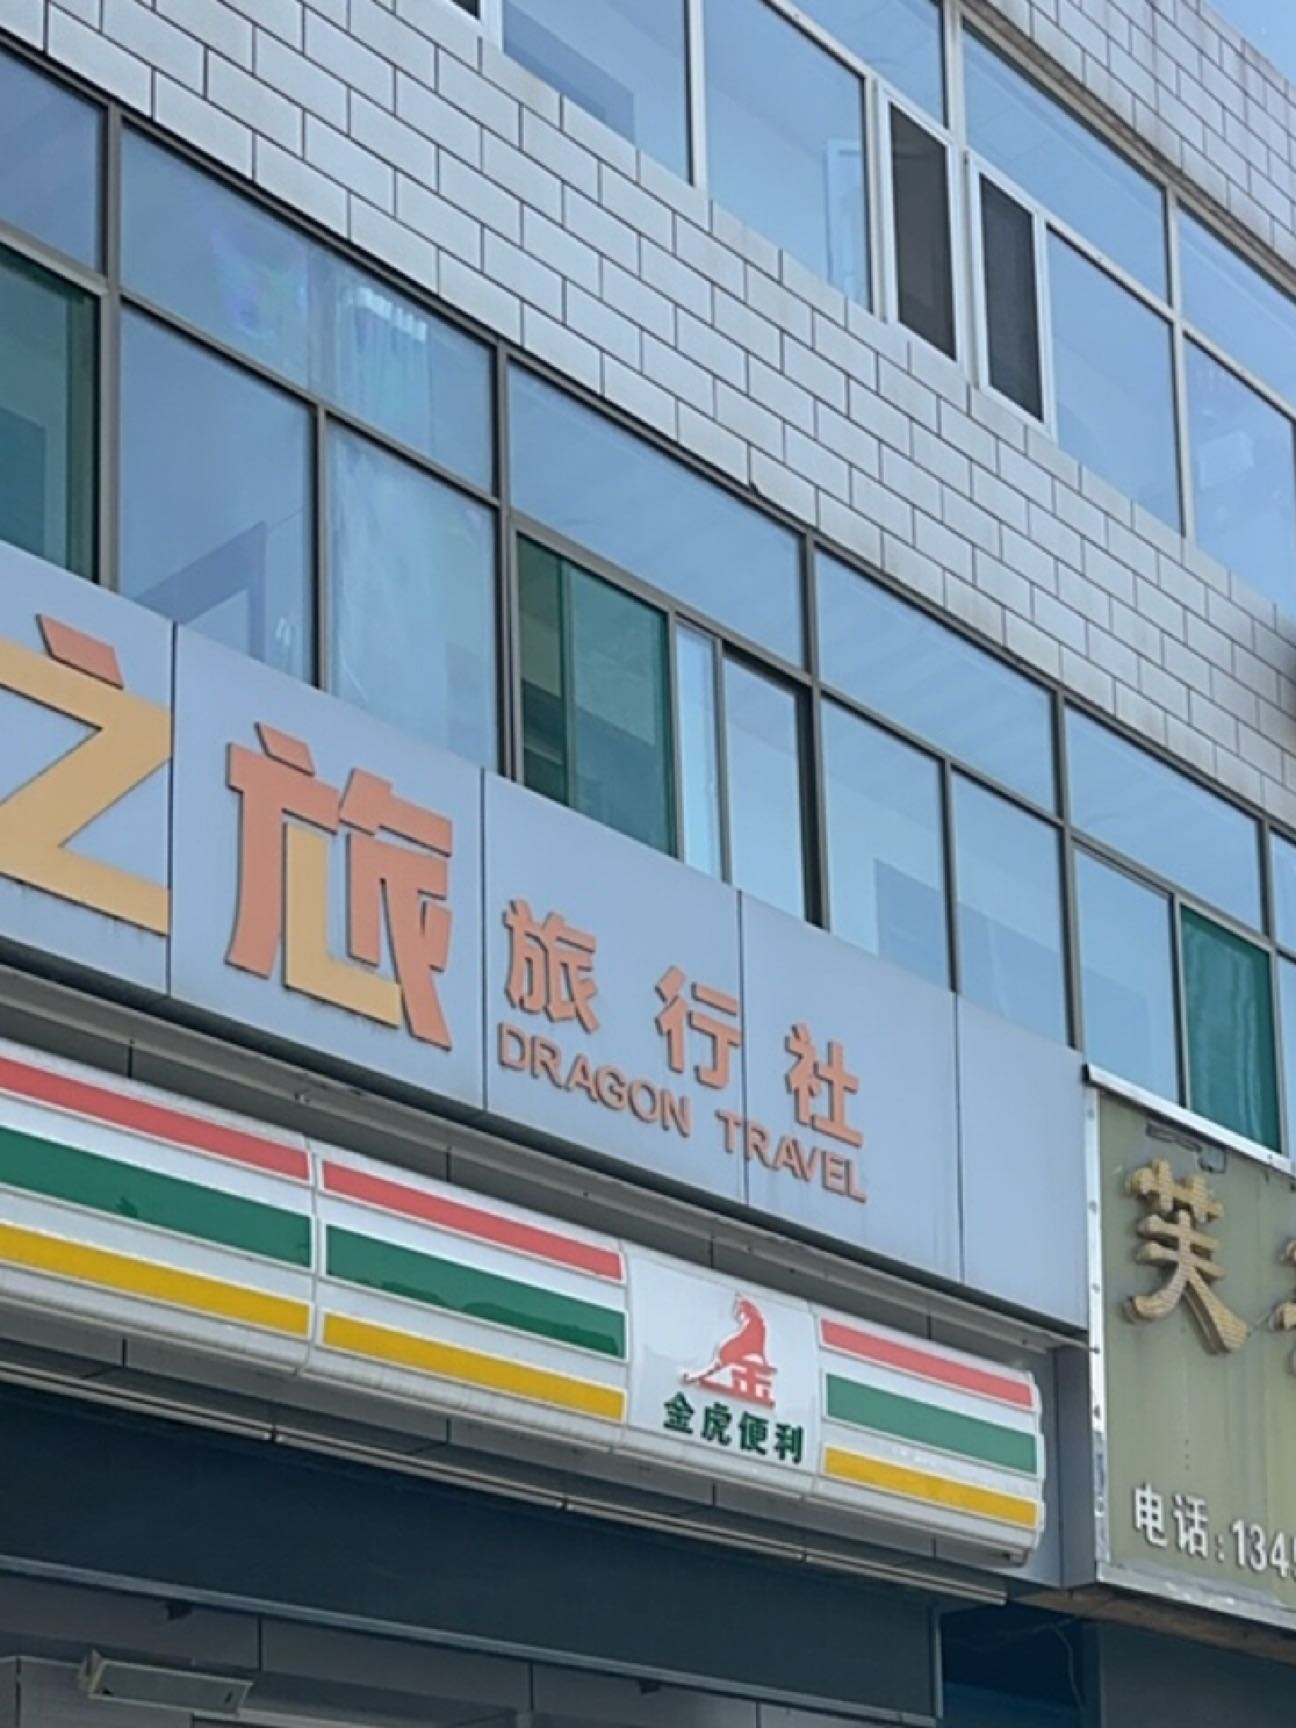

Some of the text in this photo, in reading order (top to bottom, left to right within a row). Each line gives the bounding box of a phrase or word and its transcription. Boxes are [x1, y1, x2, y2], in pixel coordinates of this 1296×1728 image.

[497, 1022, 867, 1204] DRAGON TRAVEL
[502, 899, 863, 1148] 旅行社
[663, 1391, 804, 1464] 金虎便利
